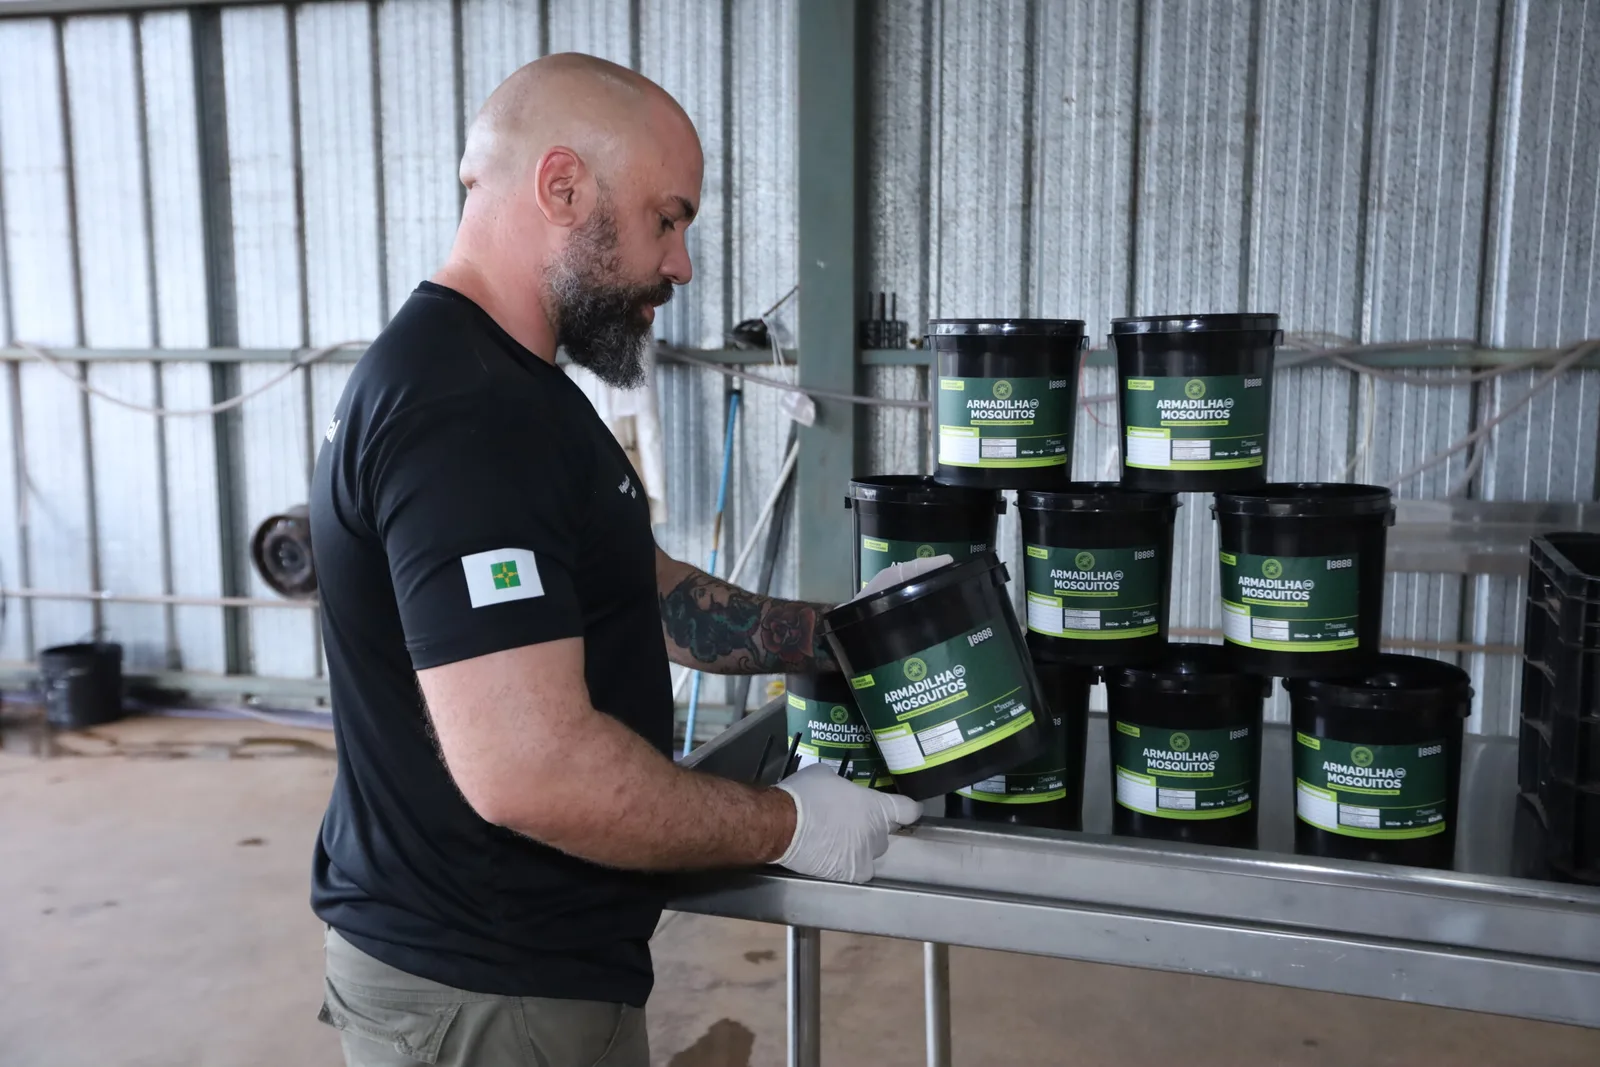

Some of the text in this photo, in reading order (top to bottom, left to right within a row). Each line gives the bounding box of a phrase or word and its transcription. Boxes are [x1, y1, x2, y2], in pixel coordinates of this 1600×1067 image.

[966, 400, 1030, 409] ARMADILHA
[1156, 399, 1224, 409] ARMADILHA
[970, 410, 1035, 419] MOSQUITOS
[1161, 409, 1230, 420] MOSQUITOS
[1050, 569, 1113, 580] ARMADILHA
[1054, 580, 1120, 590] MOSQUITOS
[1238, 576, 1302, 590] ARMADILHA
[1242, 586, 1310, 600] MOSQUITOS
[972, 627, 993, 645] 8888
[884, 670, 956, 704] ARMADILHA
[892, 678, 967, 714] MOSQUITOS
[808, 720, 866, 733] ARMADILHA
[811, 730, 871, 742] MOSQUITOS
[1142, 748, 1209, 761] ARMADILHA
[1147, 758, 1216, 771] MOSQUITOS
[1322, 761, 1394, 778] ARMADILHA
[1327, 772, 1402, 788] MOSQUITOS
